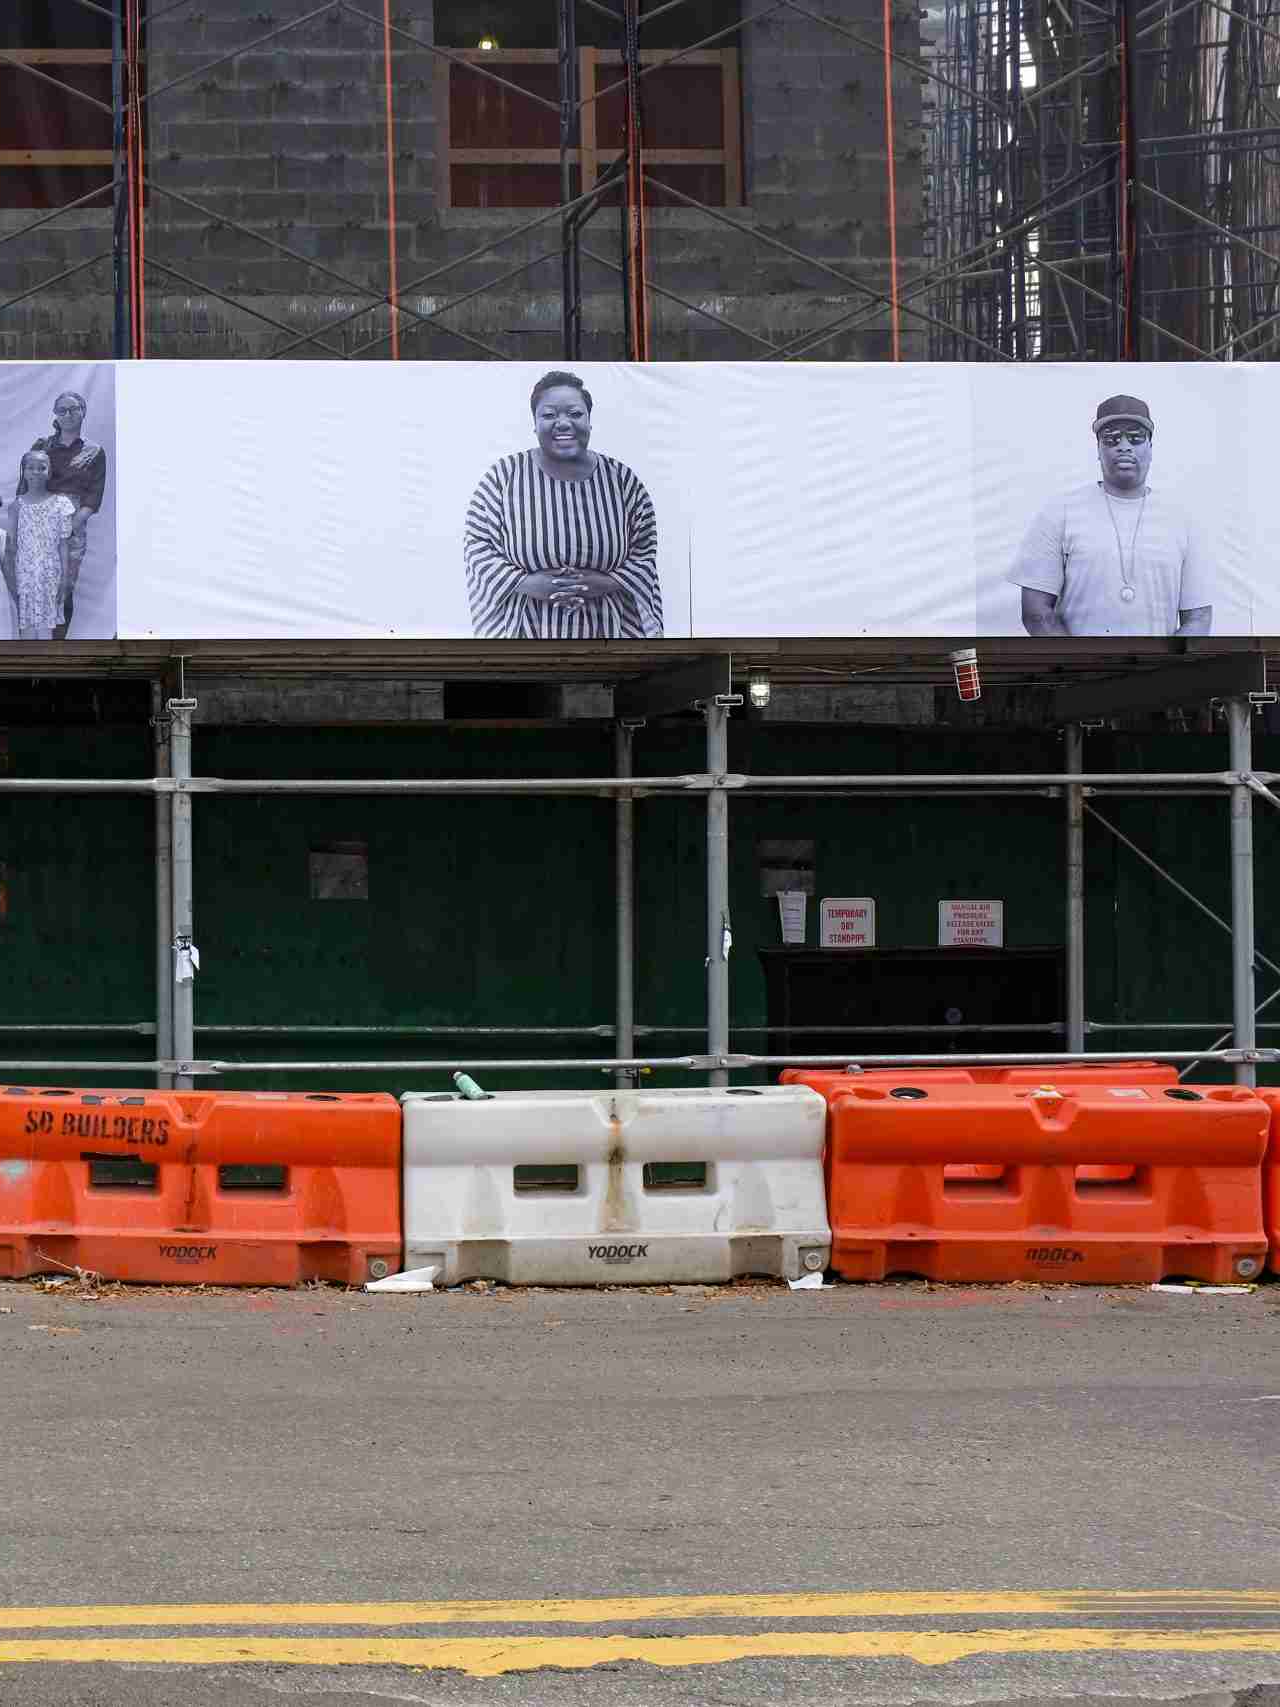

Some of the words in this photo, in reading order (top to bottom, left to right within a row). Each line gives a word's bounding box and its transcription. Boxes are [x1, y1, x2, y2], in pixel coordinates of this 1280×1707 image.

[25, 1109, 54, 1134] SD
[61, 1112, 171, 1147] BUILDERS
[159, 1245, 218, 1259] YODOCK
[588, 1244, 649, 1258] YODOCK
